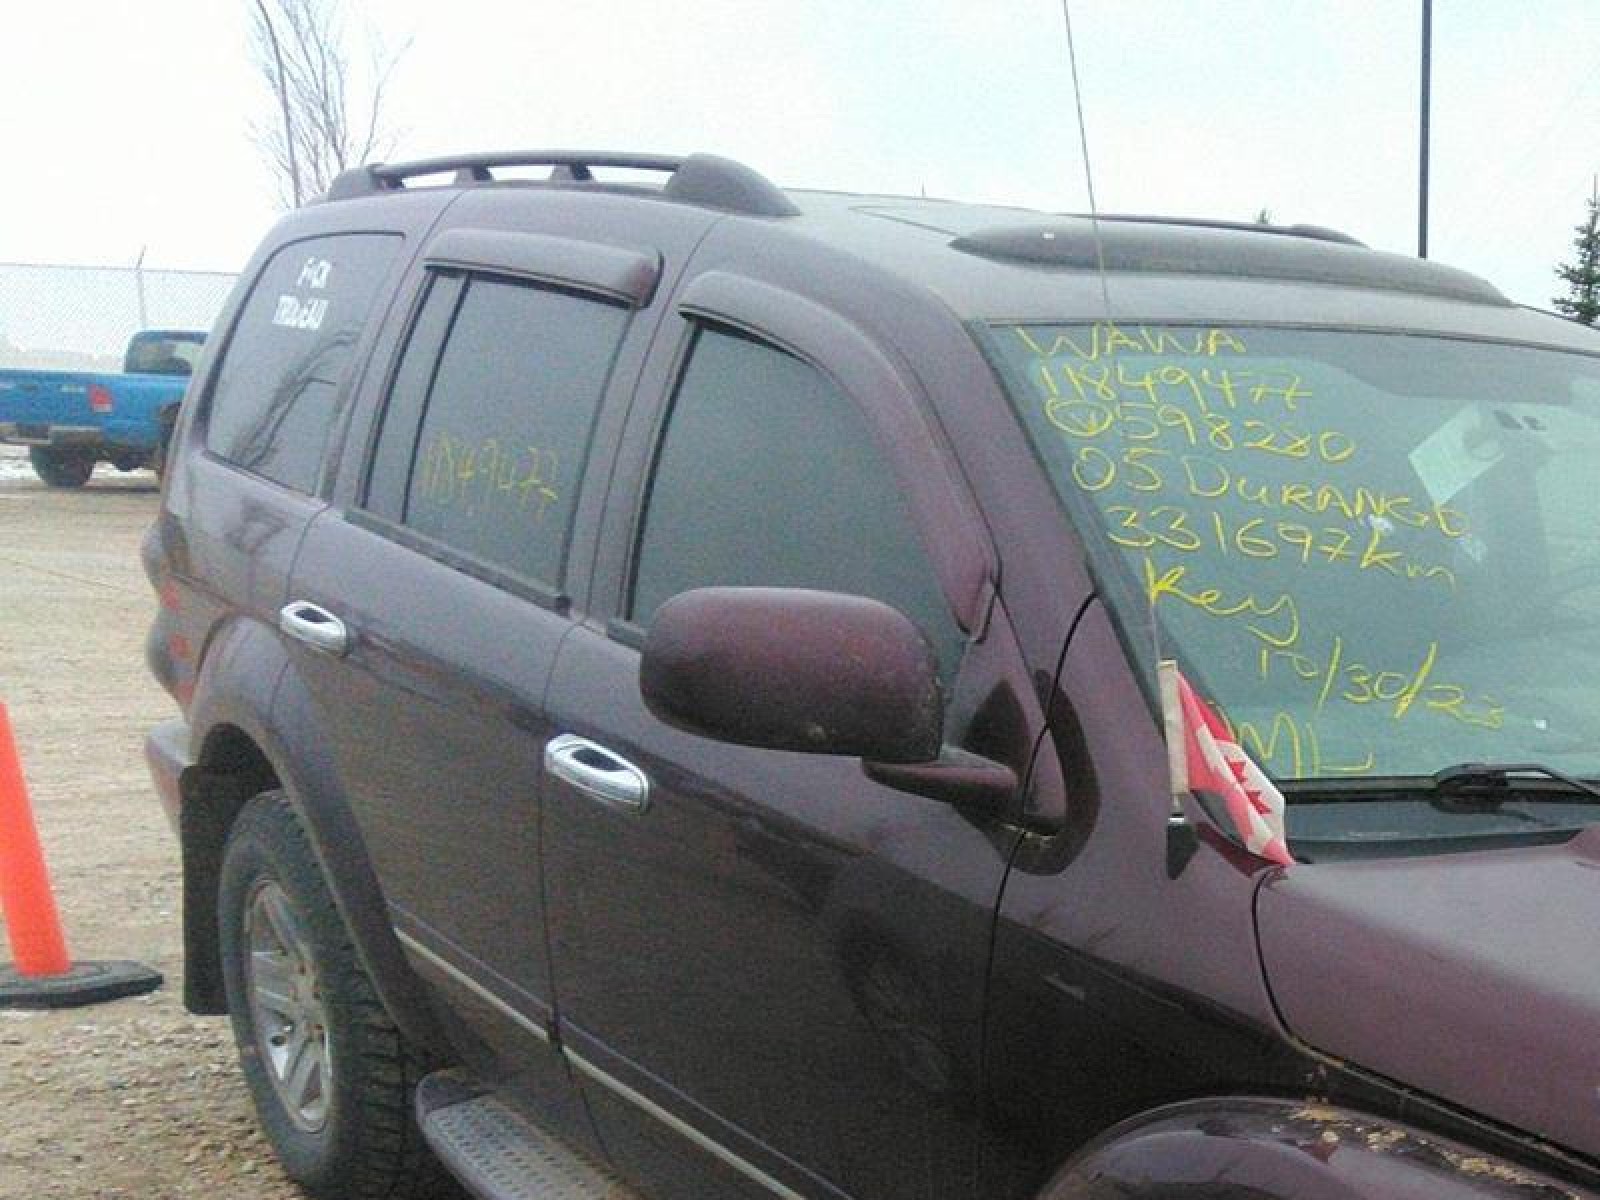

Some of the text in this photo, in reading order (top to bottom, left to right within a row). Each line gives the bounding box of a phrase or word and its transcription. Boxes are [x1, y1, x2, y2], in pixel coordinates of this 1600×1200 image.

[1016, 324, 1247, 360] WAWA
[1040, 362, 1313, 413] 11849477
[1073, 447, 1169, 491] 05
